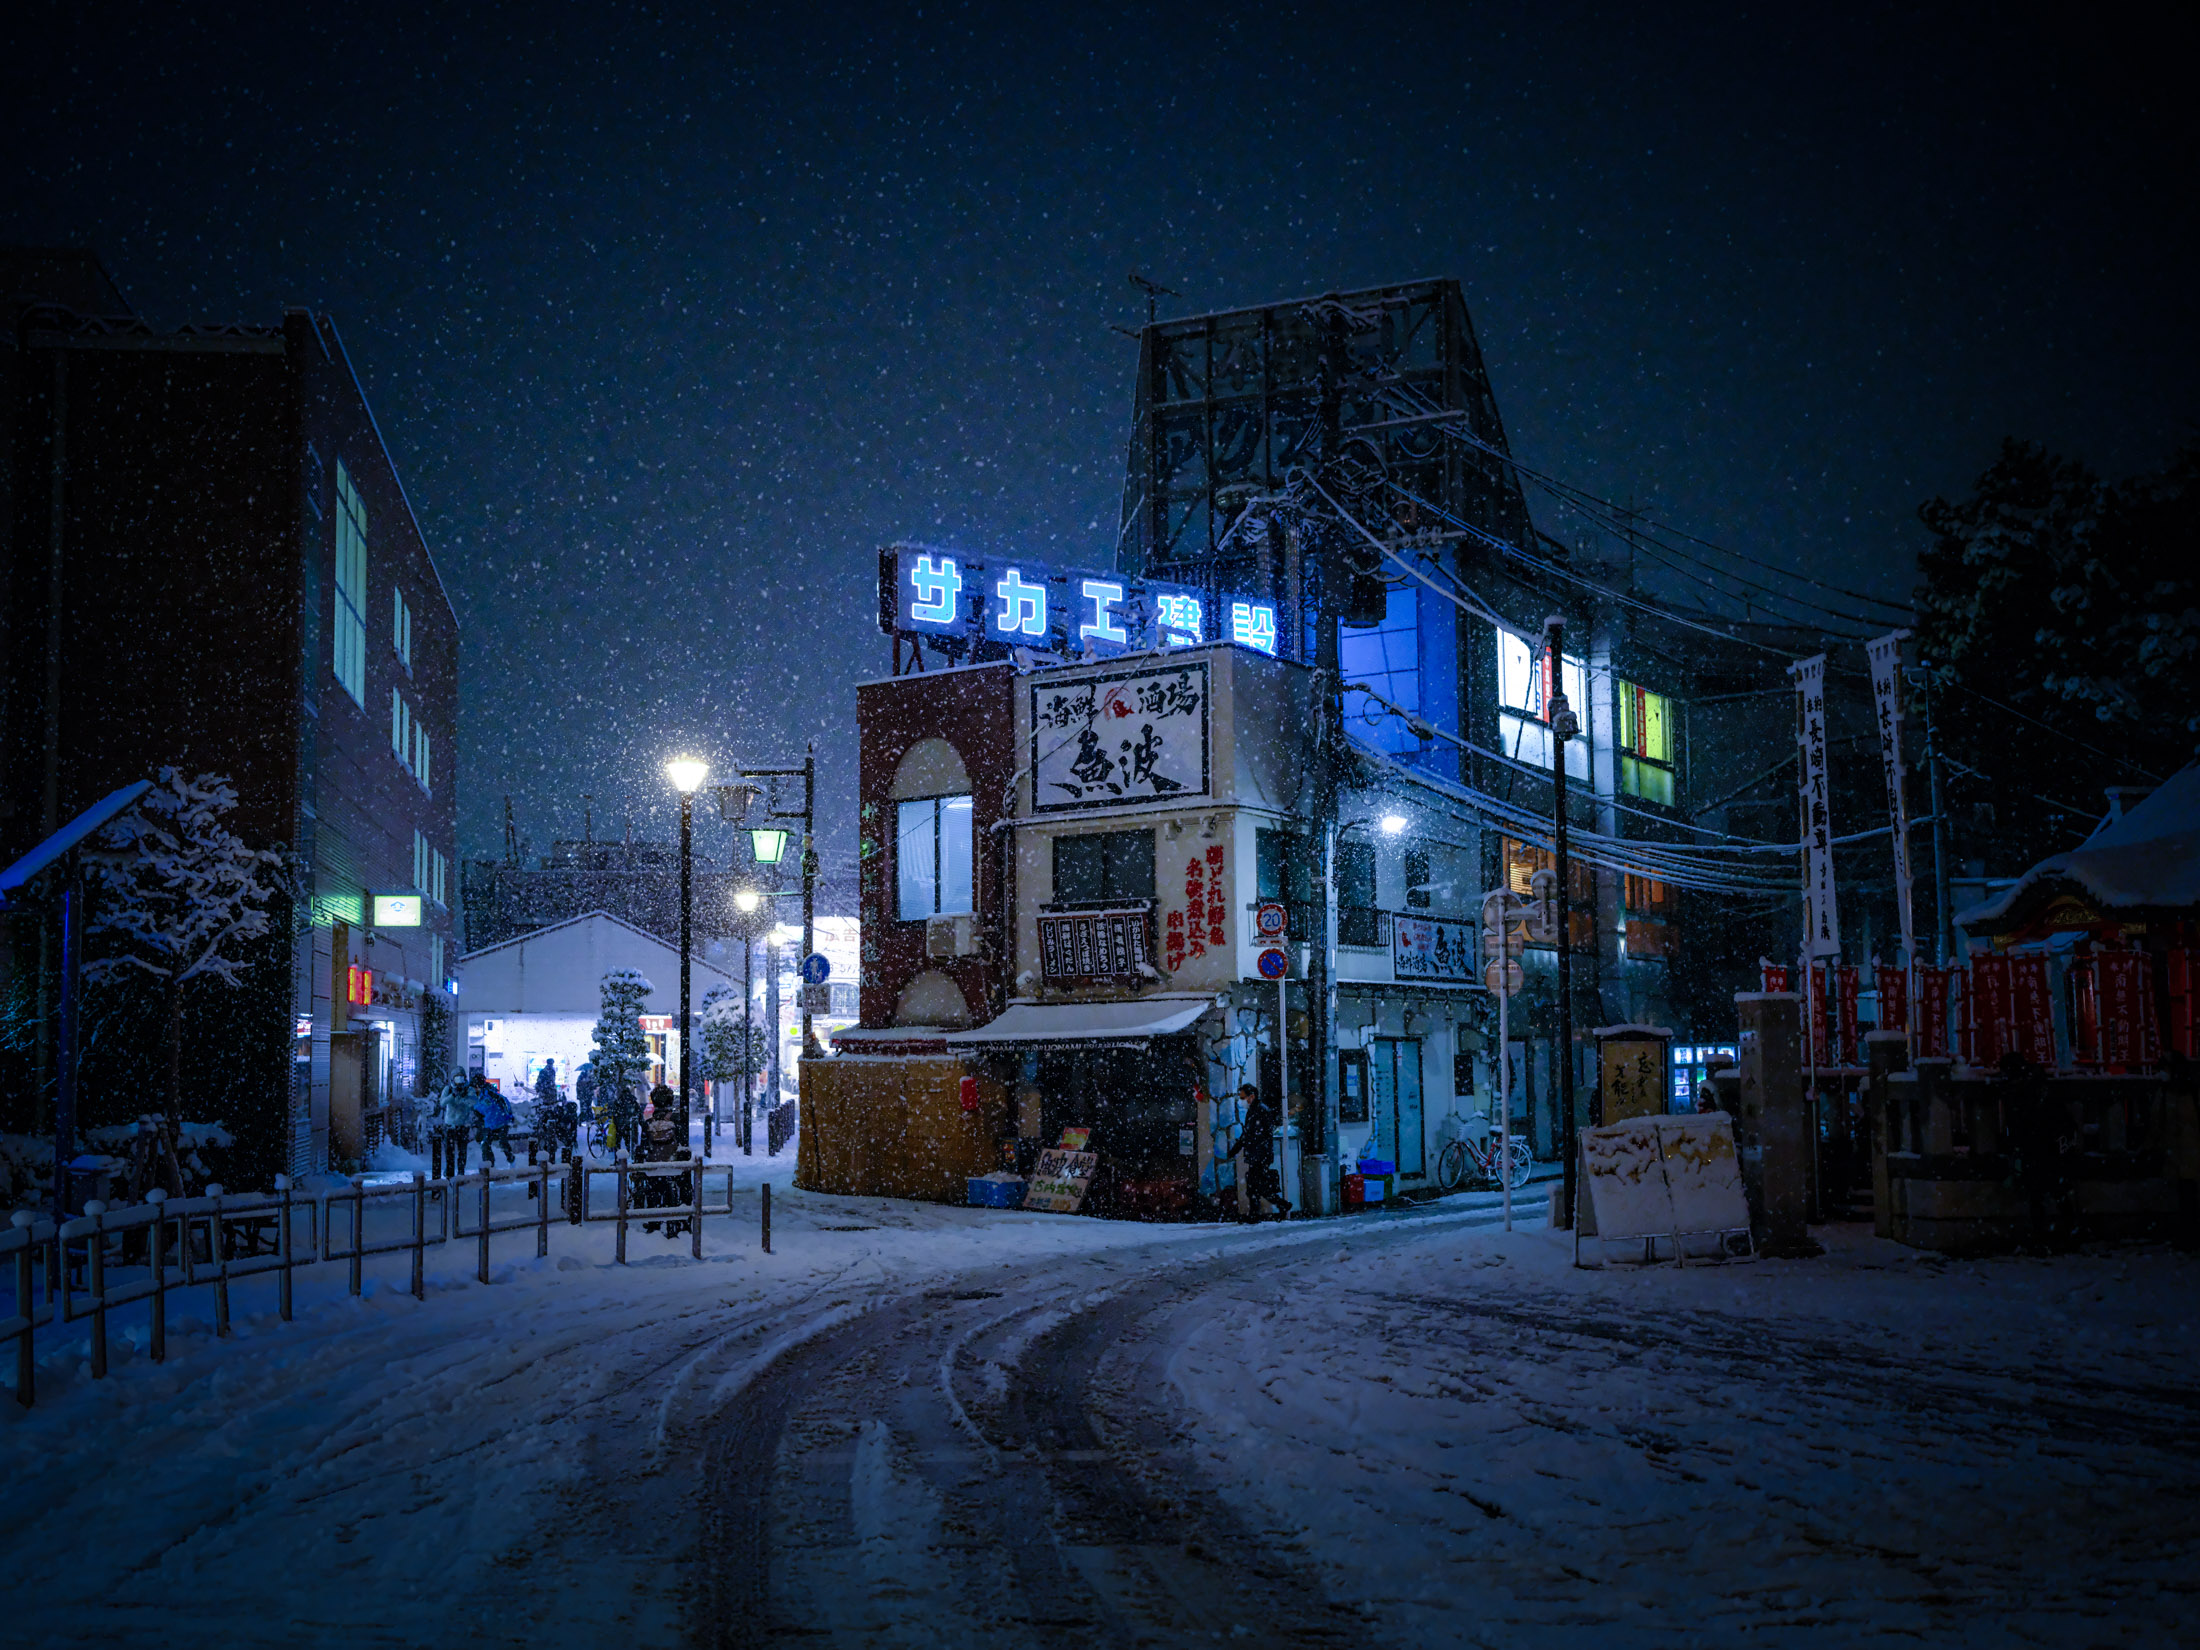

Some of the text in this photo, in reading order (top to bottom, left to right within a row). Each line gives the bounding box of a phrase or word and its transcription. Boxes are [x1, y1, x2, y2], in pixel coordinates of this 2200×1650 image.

[911, 555, 1276, 656] サカエ建設
[1039, 671, 1200, 729] 海鮮 酒場
[1049, 723, 1189, 799] 魚波
[1807, 718, 1828, 855] 長崎不動尊
[1185, 857, 1206, 960] 名物煮込み
[1206, 845, 1226, 946] 朝どれ鮮魚
[1263, 912, 1281, 927] 20
[1166, 910, 1187, 972] 串揚げ
